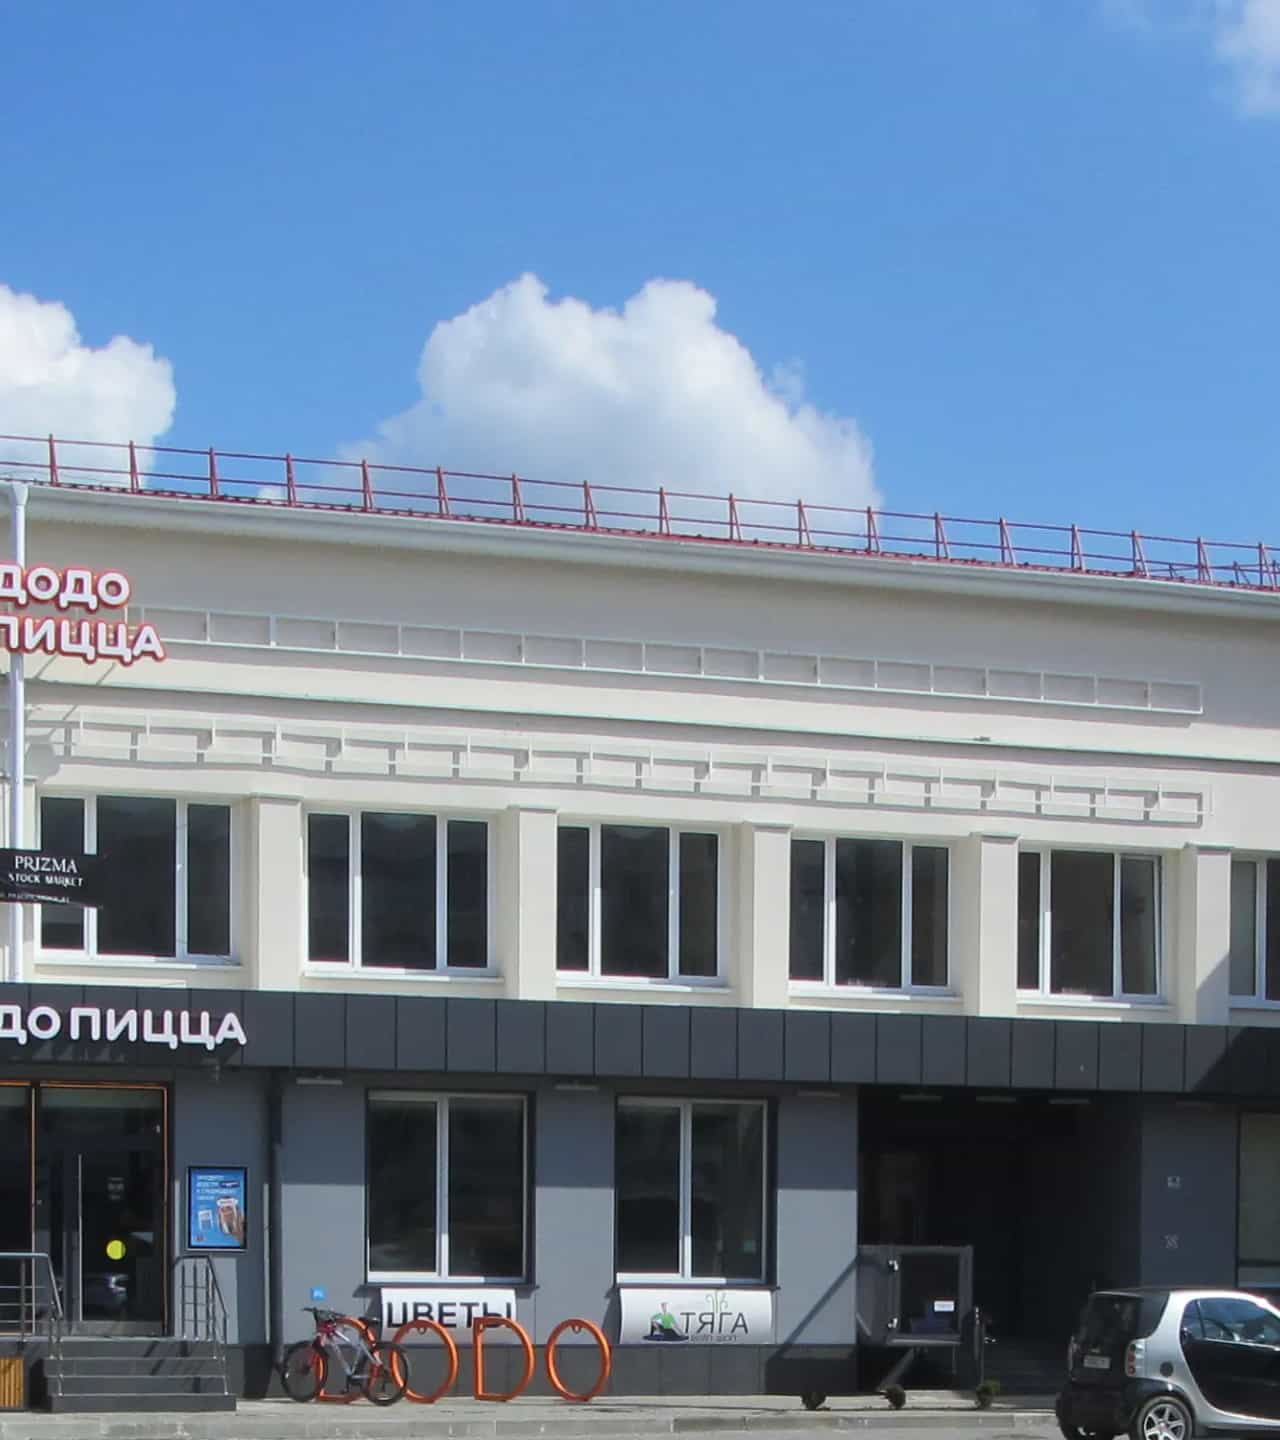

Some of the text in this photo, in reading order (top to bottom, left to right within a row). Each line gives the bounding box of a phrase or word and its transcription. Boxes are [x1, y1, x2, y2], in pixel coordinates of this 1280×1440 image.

[15, 855, 78, 873] PRIZMA
[8, 873, 83, 887] STOCK MARKET
[69, 1007, 248, 1050] ПИЦЦА
[386, 1301, 512, 1329] ЦВЕТЫ
[679, 1312, 749, 1335] ТЯГА
